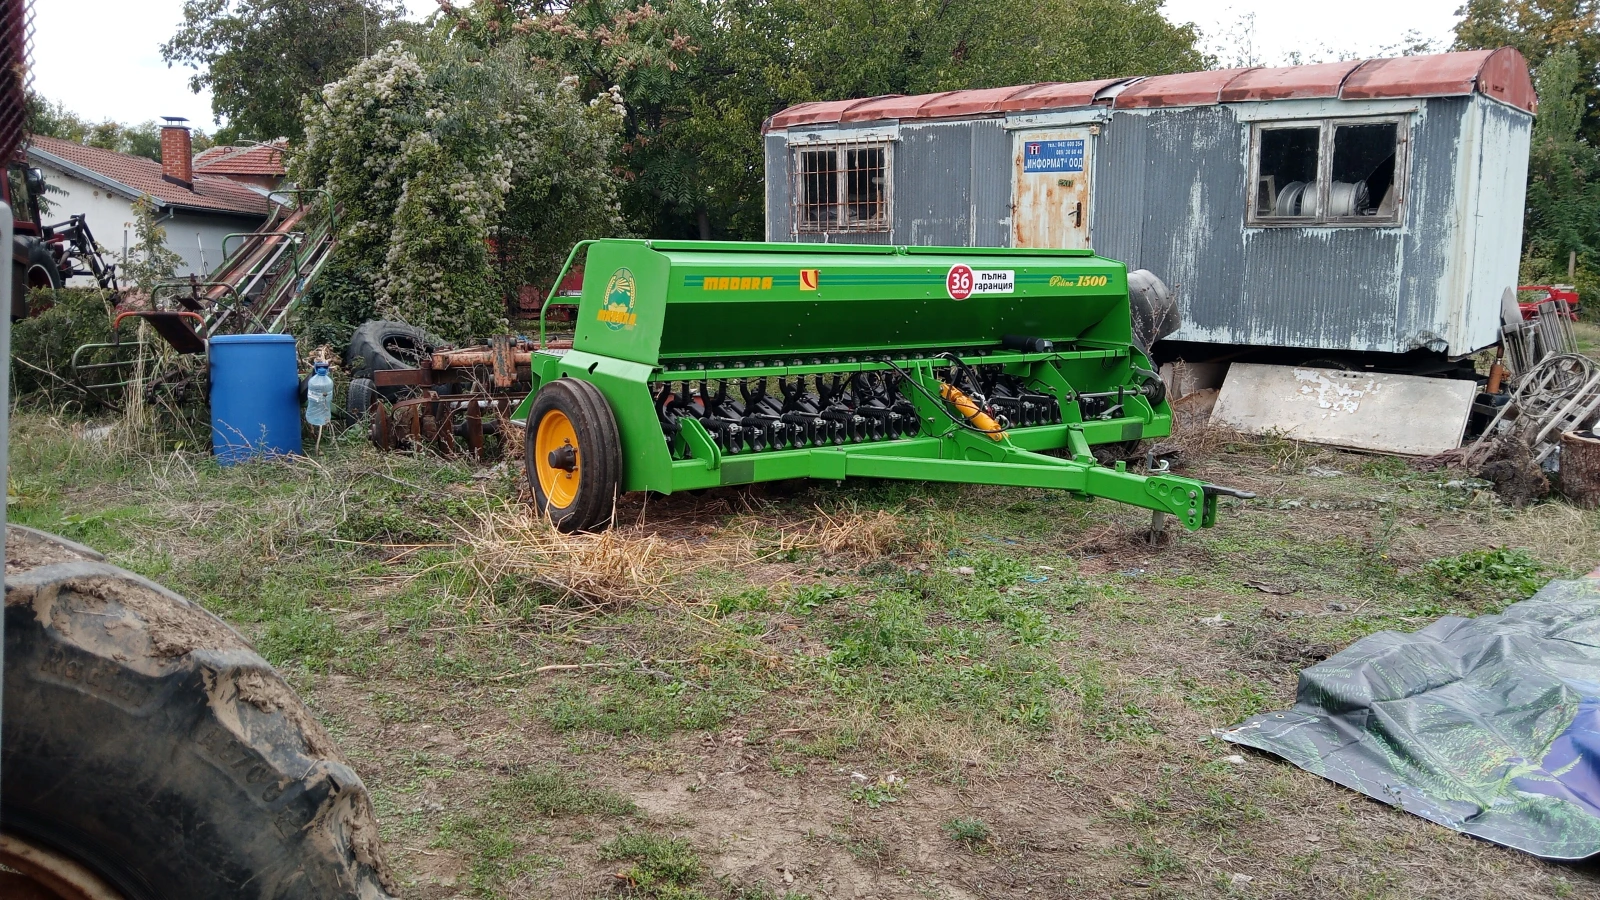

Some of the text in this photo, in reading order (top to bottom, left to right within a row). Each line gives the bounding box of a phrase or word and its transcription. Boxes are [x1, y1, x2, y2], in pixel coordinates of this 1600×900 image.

[1068, 157, 1083, 169] ООД
[951, 273, 970, 289] 36
[981, 271, 1007, 281] пълна
[1049, 275, 1108, 287] Polina 1500
[703, 276, 773, 291] MADARA
[974, 281, 1013, 292] гаранция
